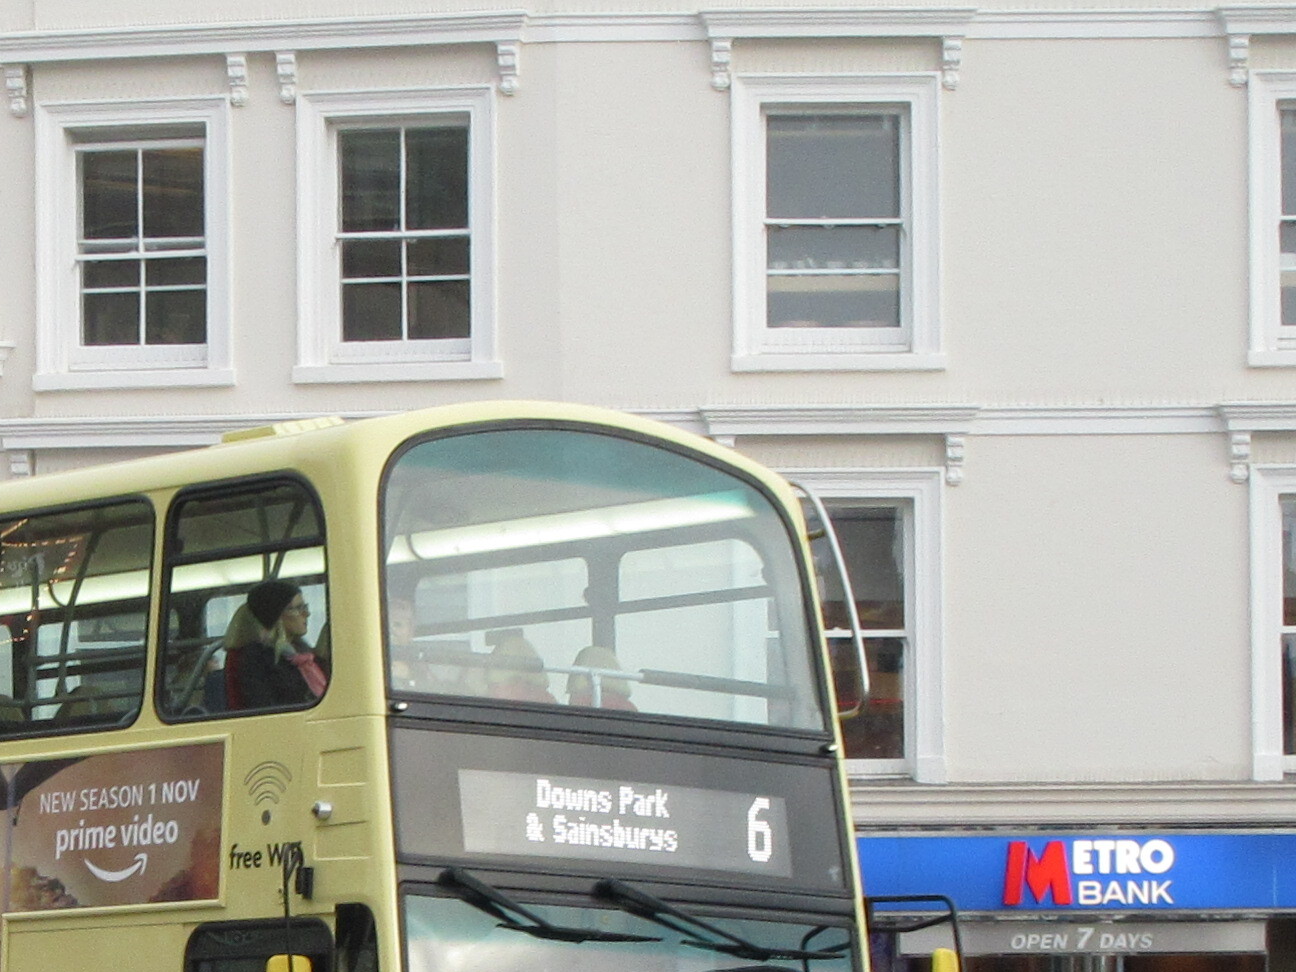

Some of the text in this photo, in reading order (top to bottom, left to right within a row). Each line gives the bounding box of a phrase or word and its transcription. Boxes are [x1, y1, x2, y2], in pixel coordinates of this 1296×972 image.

[40, 779, 200, 814] NEW SEASON 1 NOV
[536, 779, 670, 818] Downs Park
[54, 814, 179, 860] prime video
[526, 812, 678, 852] & Sainsburys
[747, 797, 772, 862] 6
[229, 843, 262, 870] free
[1003, 839, 1174, 906] METRO
[1077, 880, 1175, 905] BANK
[1010, 928, 1154, 950] OPEN 7 DAYS
